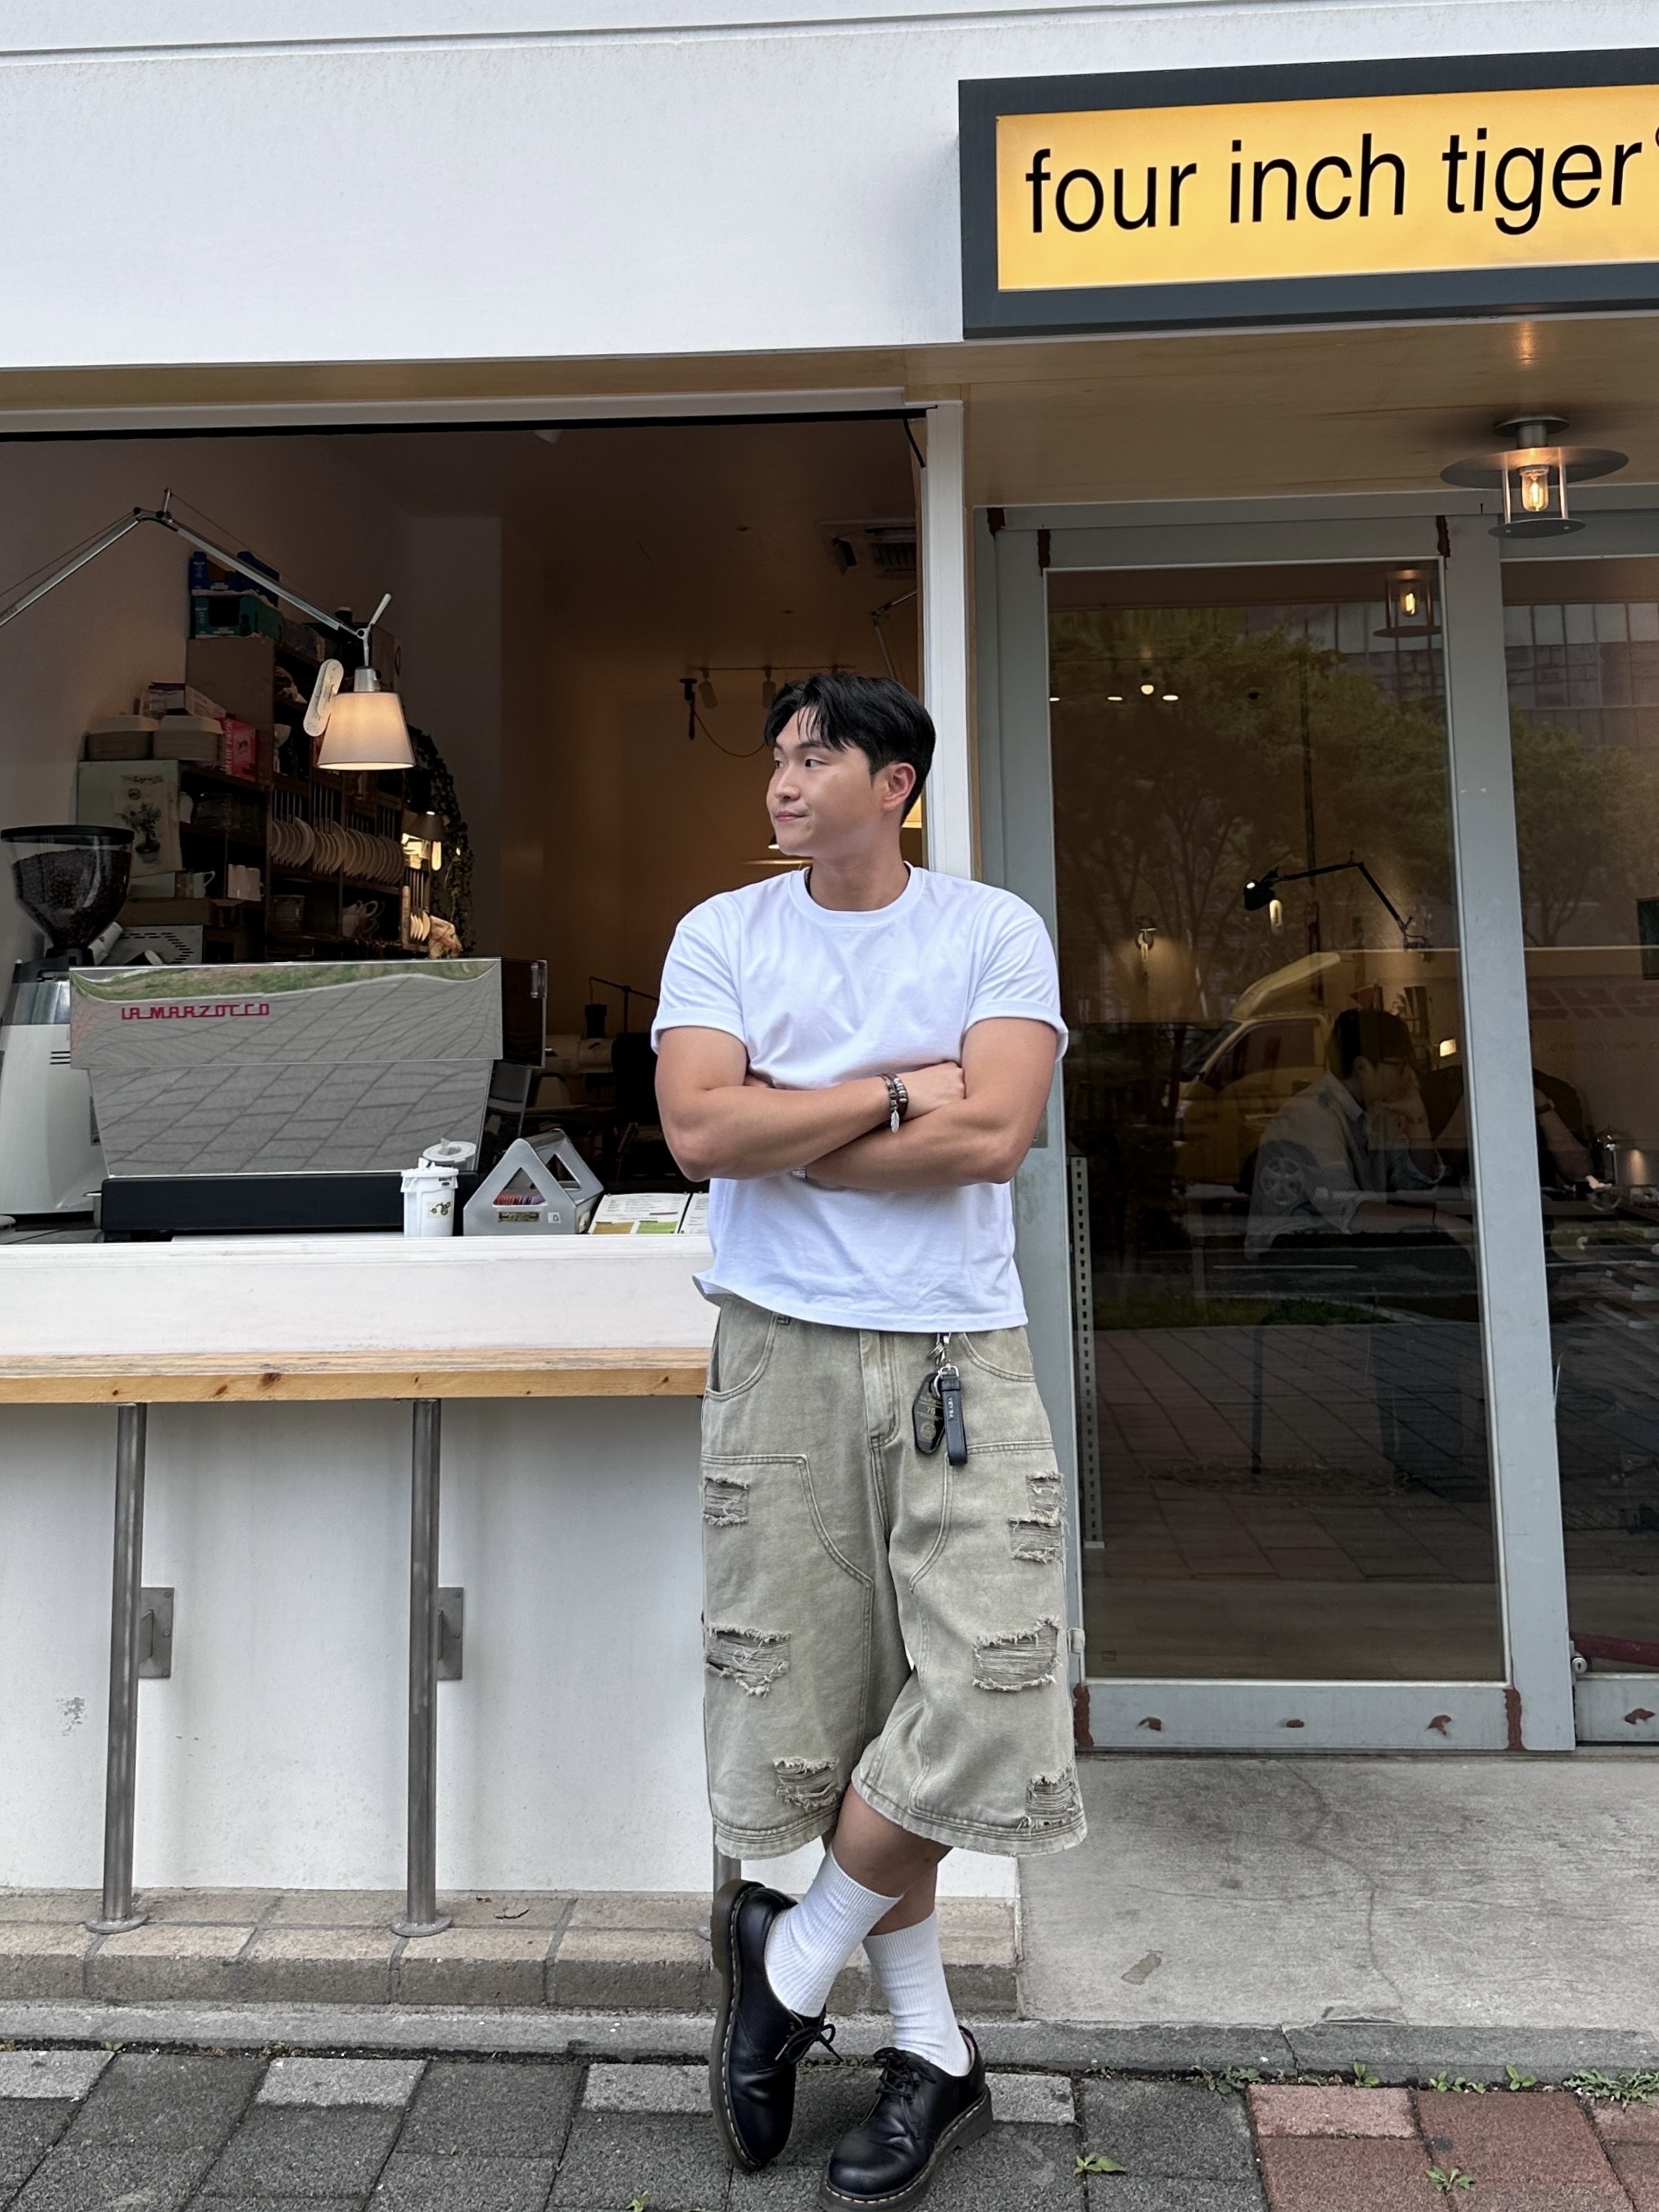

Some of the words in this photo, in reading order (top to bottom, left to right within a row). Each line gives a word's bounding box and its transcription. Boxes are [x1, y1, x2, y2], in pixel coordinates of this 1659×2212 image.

[1025, 148, 1197, 233] four
[1230, 133, 1405, 224] inch
[1441, 127, 1643, 236] tiger
[121, 1006, 141, 1020] LA
[150, 1003, 270, 1019] MARZOCCO
